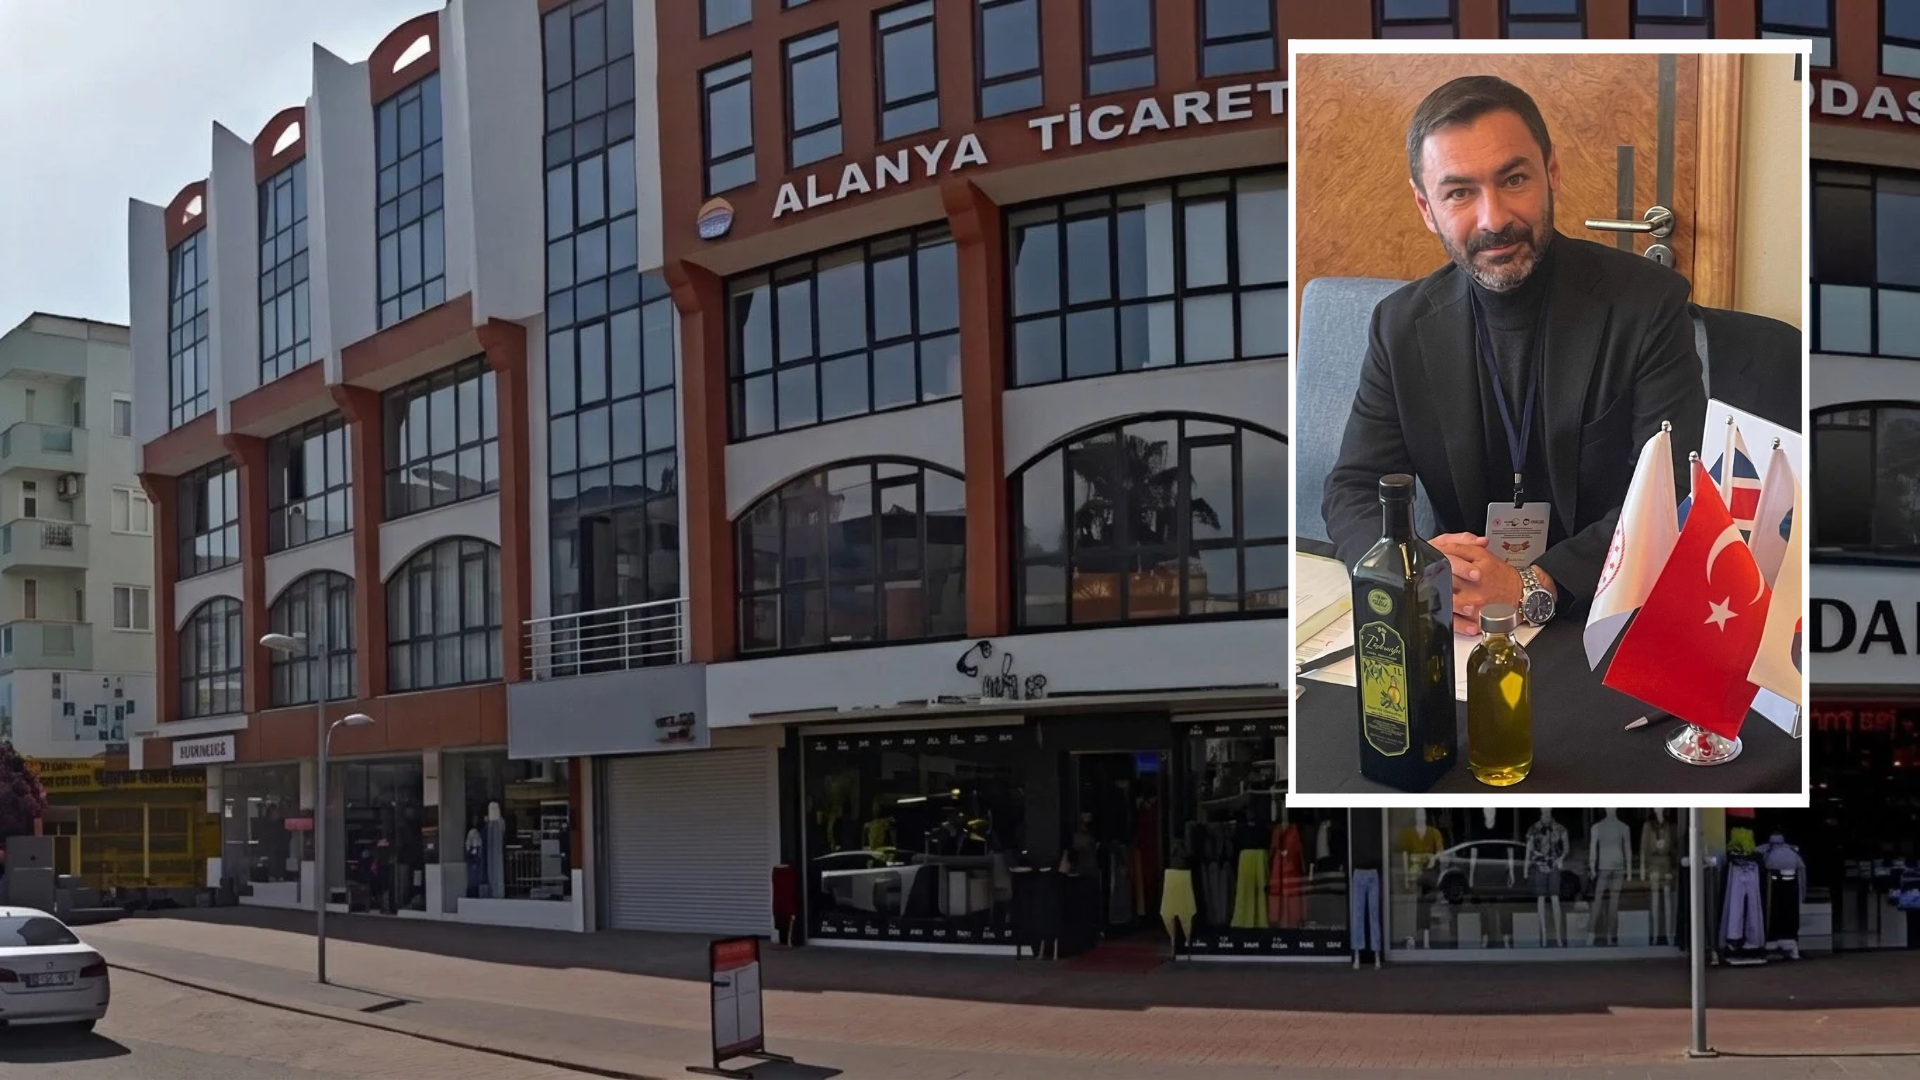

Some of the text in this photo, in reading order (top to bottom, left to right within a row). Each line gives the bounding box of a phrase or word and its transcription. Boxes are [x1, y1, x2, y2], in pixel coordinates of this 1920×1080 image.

[771, 132, 988, 220] ALANYA
[1029, 80, 1289, 152] TİCARET
[1809, 597, 1920, 655] DA
